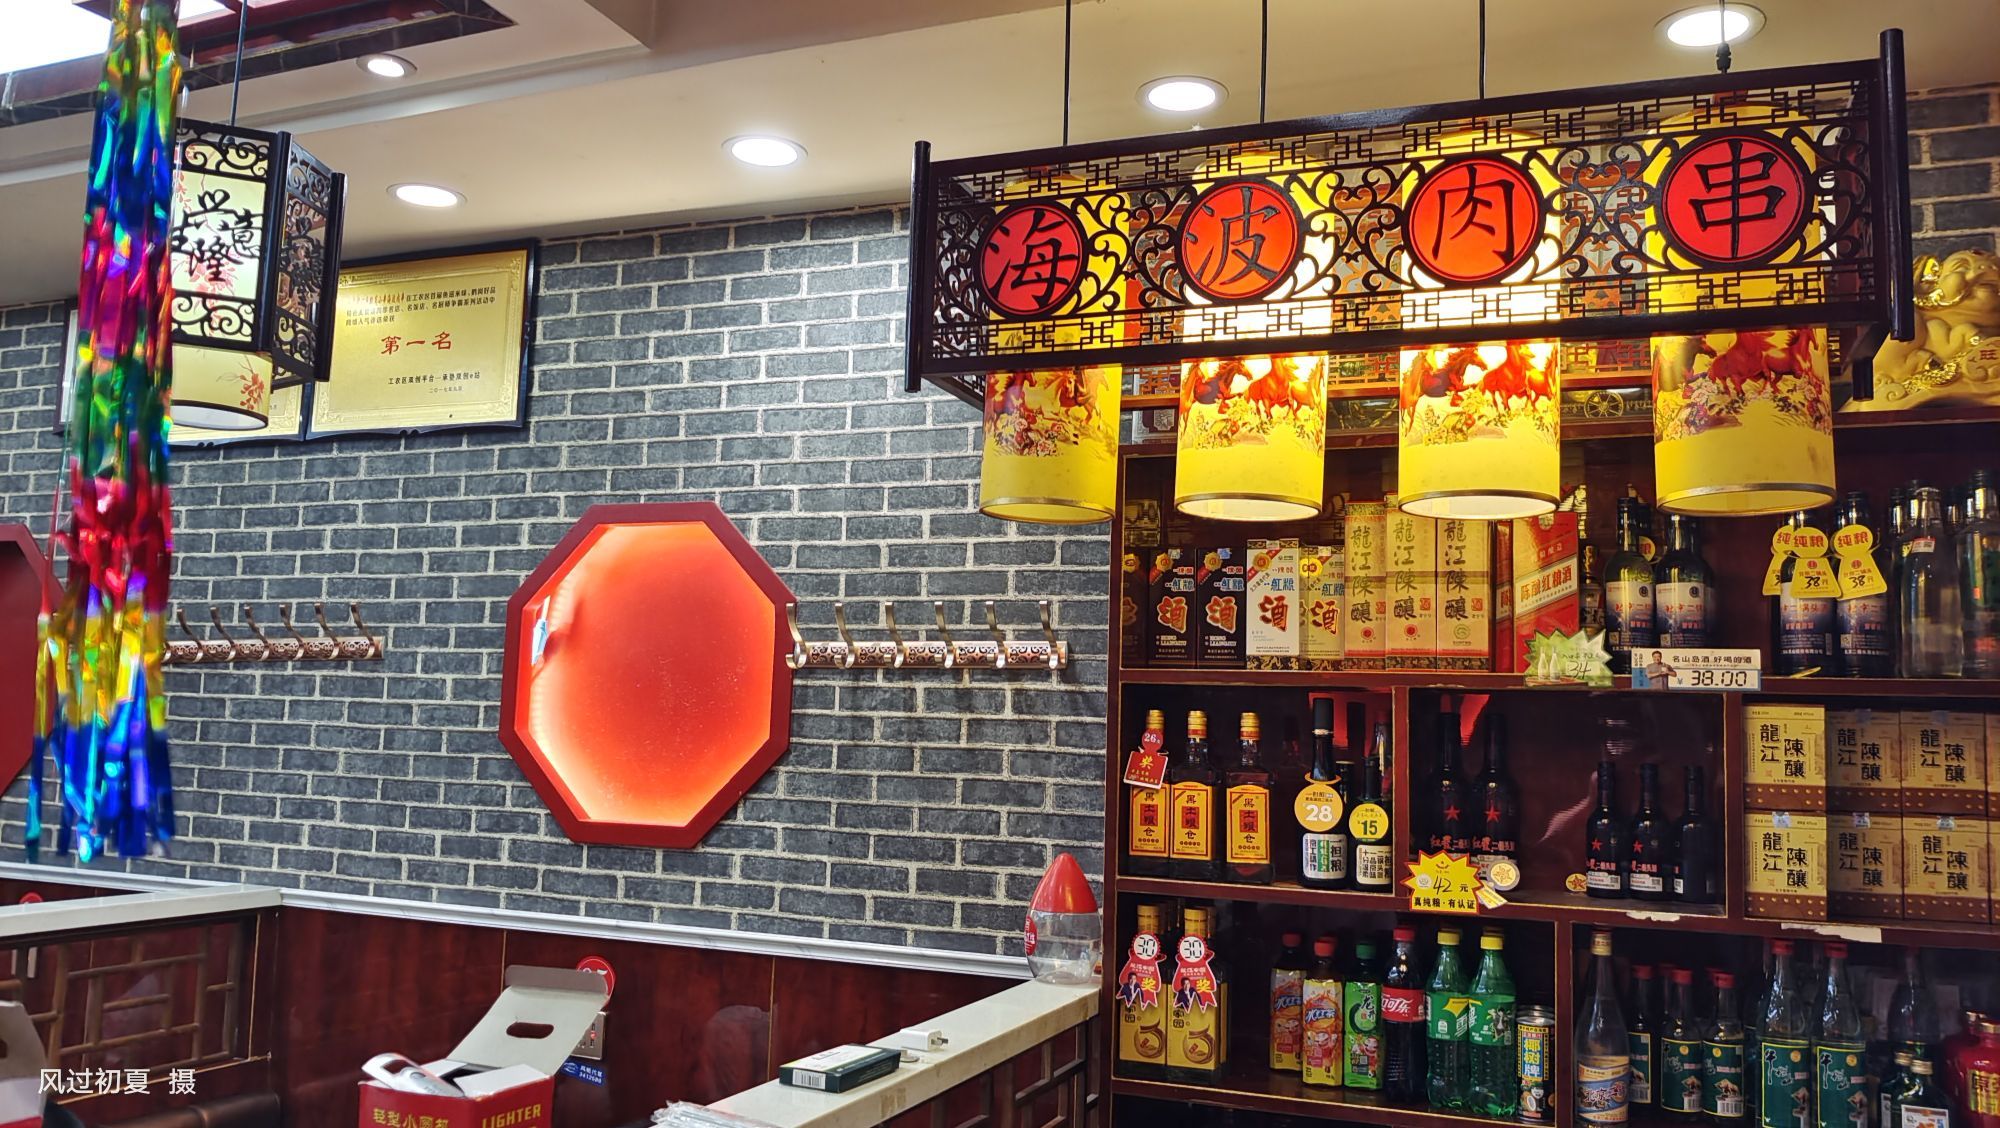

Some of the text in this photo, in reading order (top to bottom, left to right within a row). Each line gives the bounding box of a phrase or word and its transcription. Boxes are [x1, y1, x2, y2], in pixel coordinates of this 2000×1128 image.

[381, 331, 451, 355] 第一名
[1793, 535, 1825, 548] 纯粮
[1837, 531, 1869, 548] 纯粮
[1804, 575, 1821, 589] 38
[1849, 575, 1865, 589] 38
[1158, 596, 1187, 633] 酒
[1206, 596, 1237, 634] 酒
[1258, 595, 1289, 632] 酒
[1309, 600, 1339, 635] 酒
[1570, 660, 1592, 679] 34
[1691, 670, 1747, 687] 38.00
[1144, 732, 1156, 743] 26
[1760, 723, 1780, 762] 龍江
[1837, 728, 1857, 766] 龍江
[1920, 729, 1942, 768] 龍江
[1305, 804, 1333, 822] 28
[1361, 820, 1378, 836] 15
[1762, 832, 1783, 872] 龍江
[1838, 832, 1859, 871] 龍江
[1922, 835, 1943, 875] 龍江
[1433, 875, 1469, 895] 42 元
[1136, 936, 1156, 957] 30
[1183, 939, 1202, 959] 30
[1141, 977, 1157, 993] 奖
[1196, 978, 1211, 994] 奖
[1306, 1007, 1337, 1023] 冰红茶
[1523, 1038, 1541, 1077] 椰树牌
[481, 1103, 542, 1128] LIGHTER
